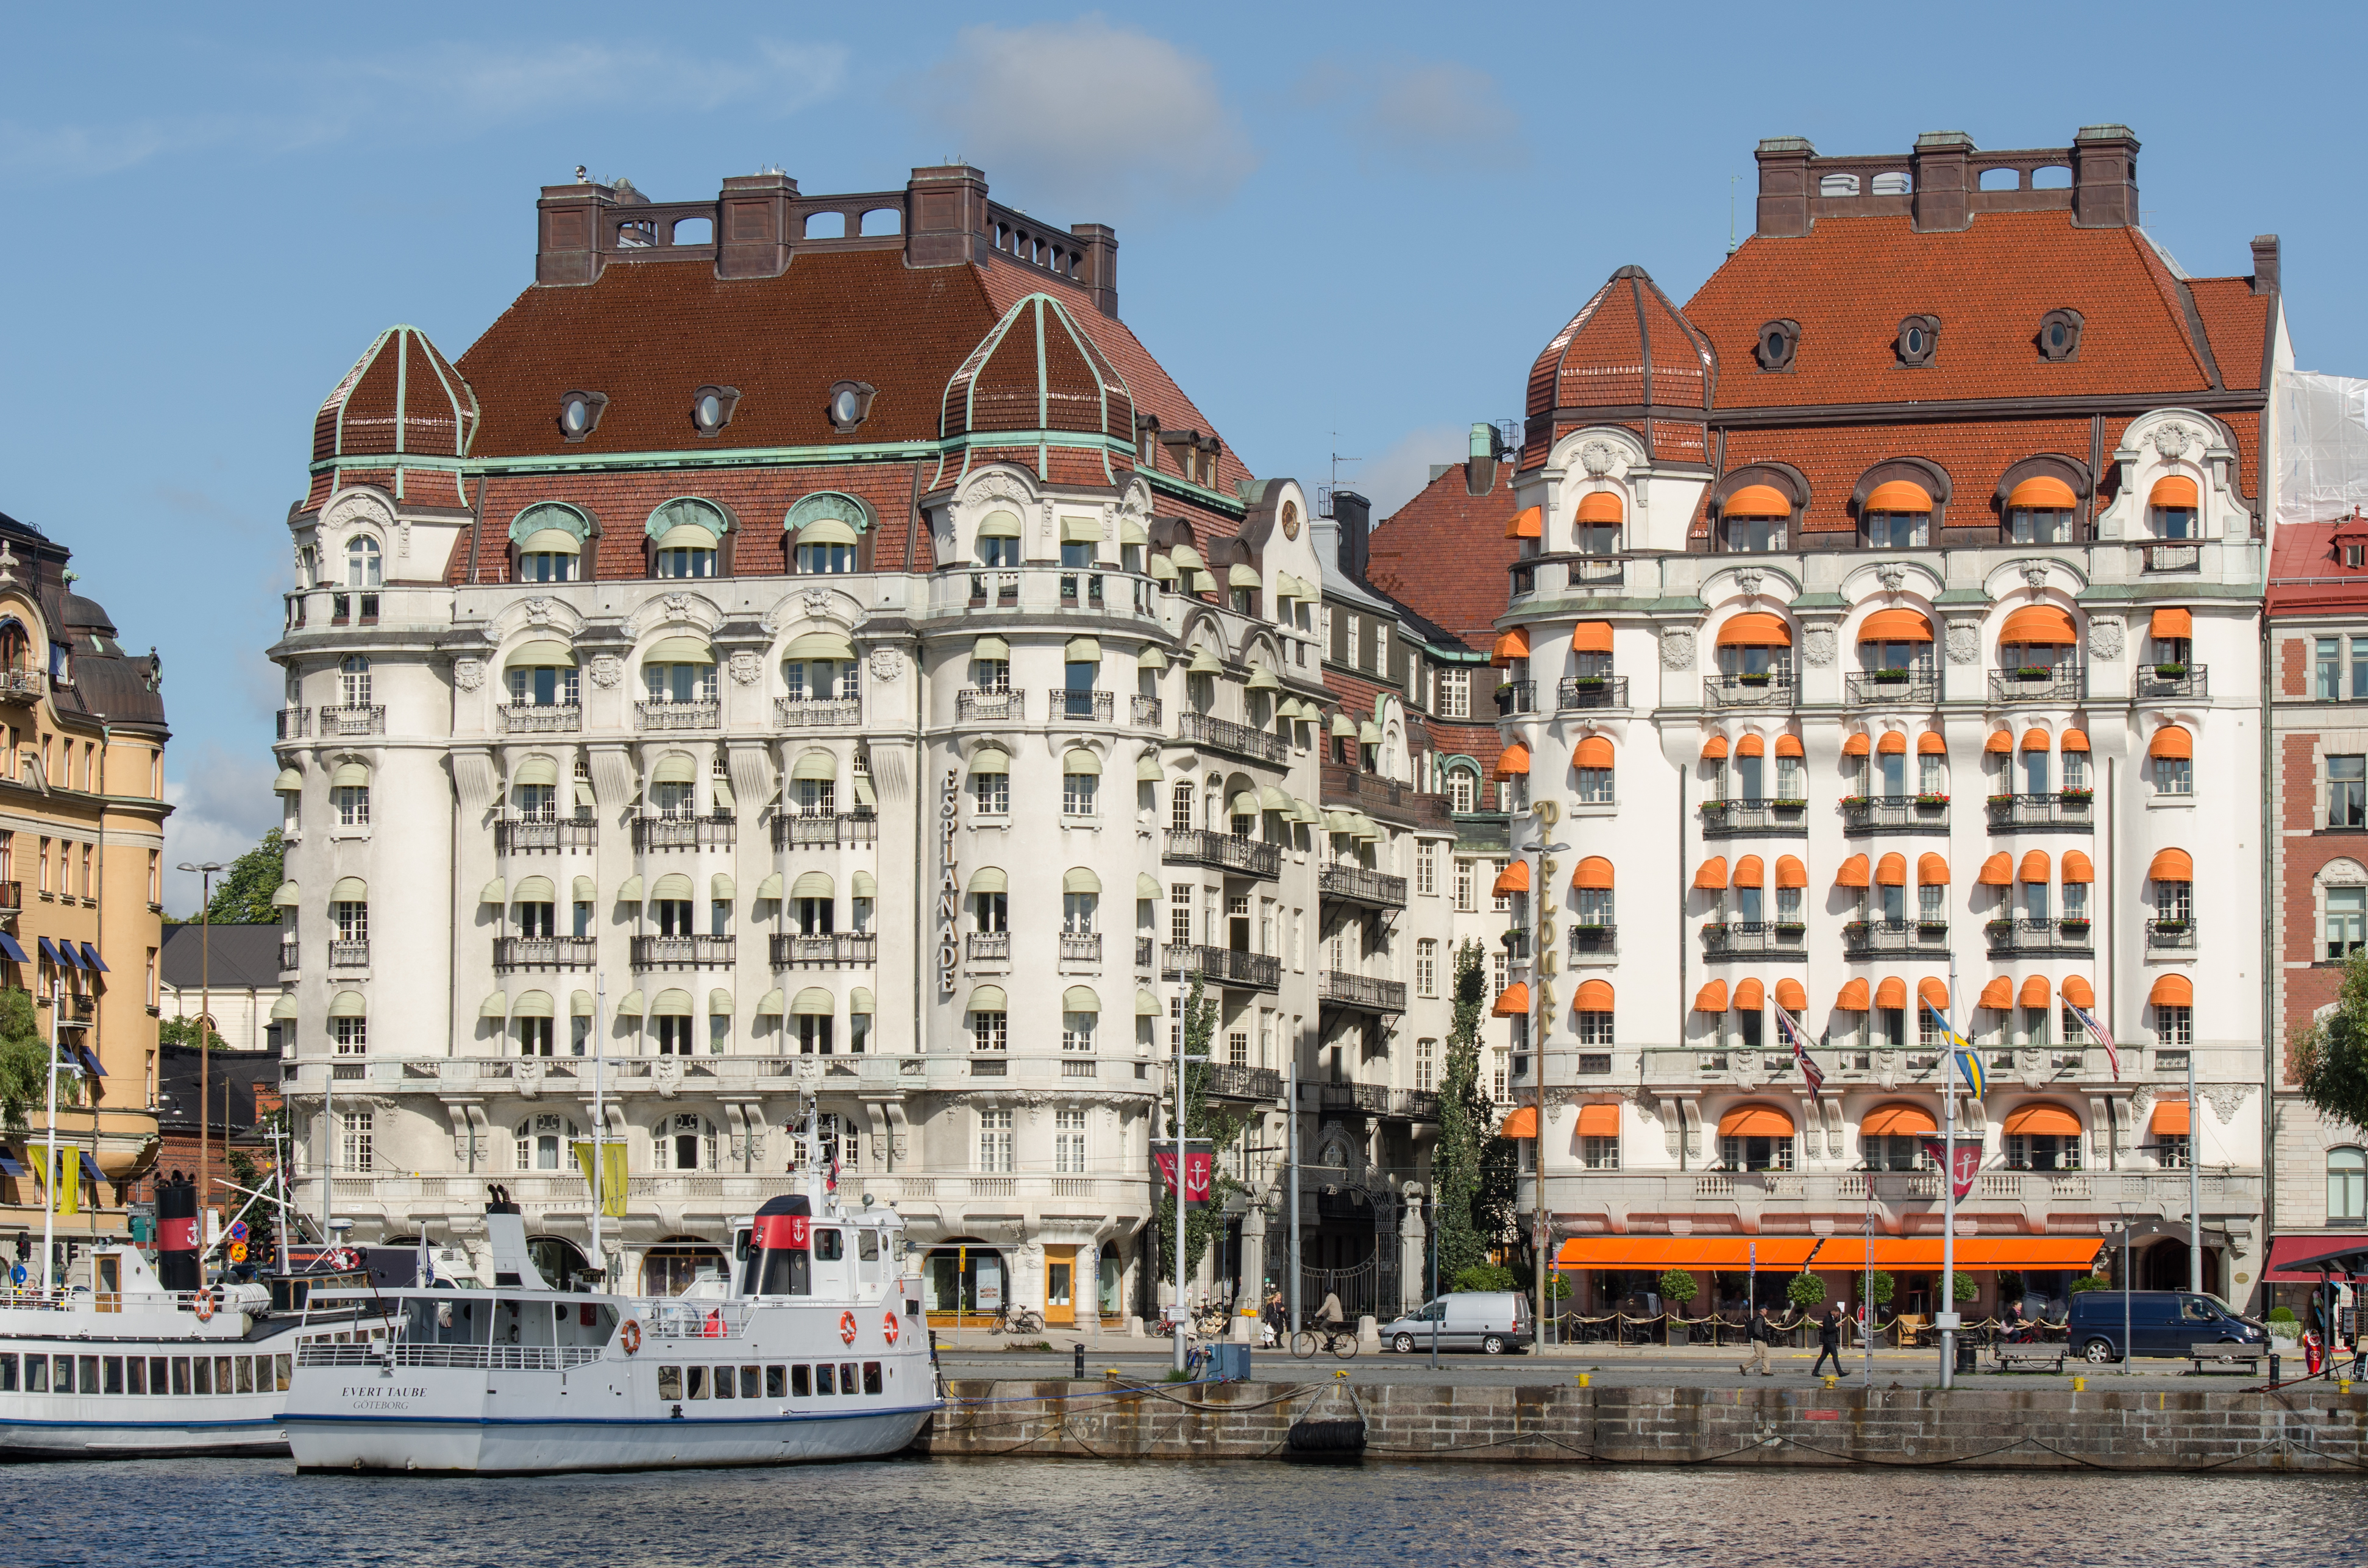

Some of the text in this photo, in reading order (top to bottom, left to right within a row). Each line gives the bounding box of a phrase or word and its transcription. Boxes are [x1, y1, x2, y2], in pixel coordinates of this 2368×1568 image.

[940, 768, 959, 993] ESPLANADE
[1532, 800, 1559, 1035] DIPLOMAT
[1326, 1183, 1337, 1195] 7B
[341, 1387, 428, 1397] EVERT TAUBE
[353, 1400, 409, 1410] GÖTEBORG
